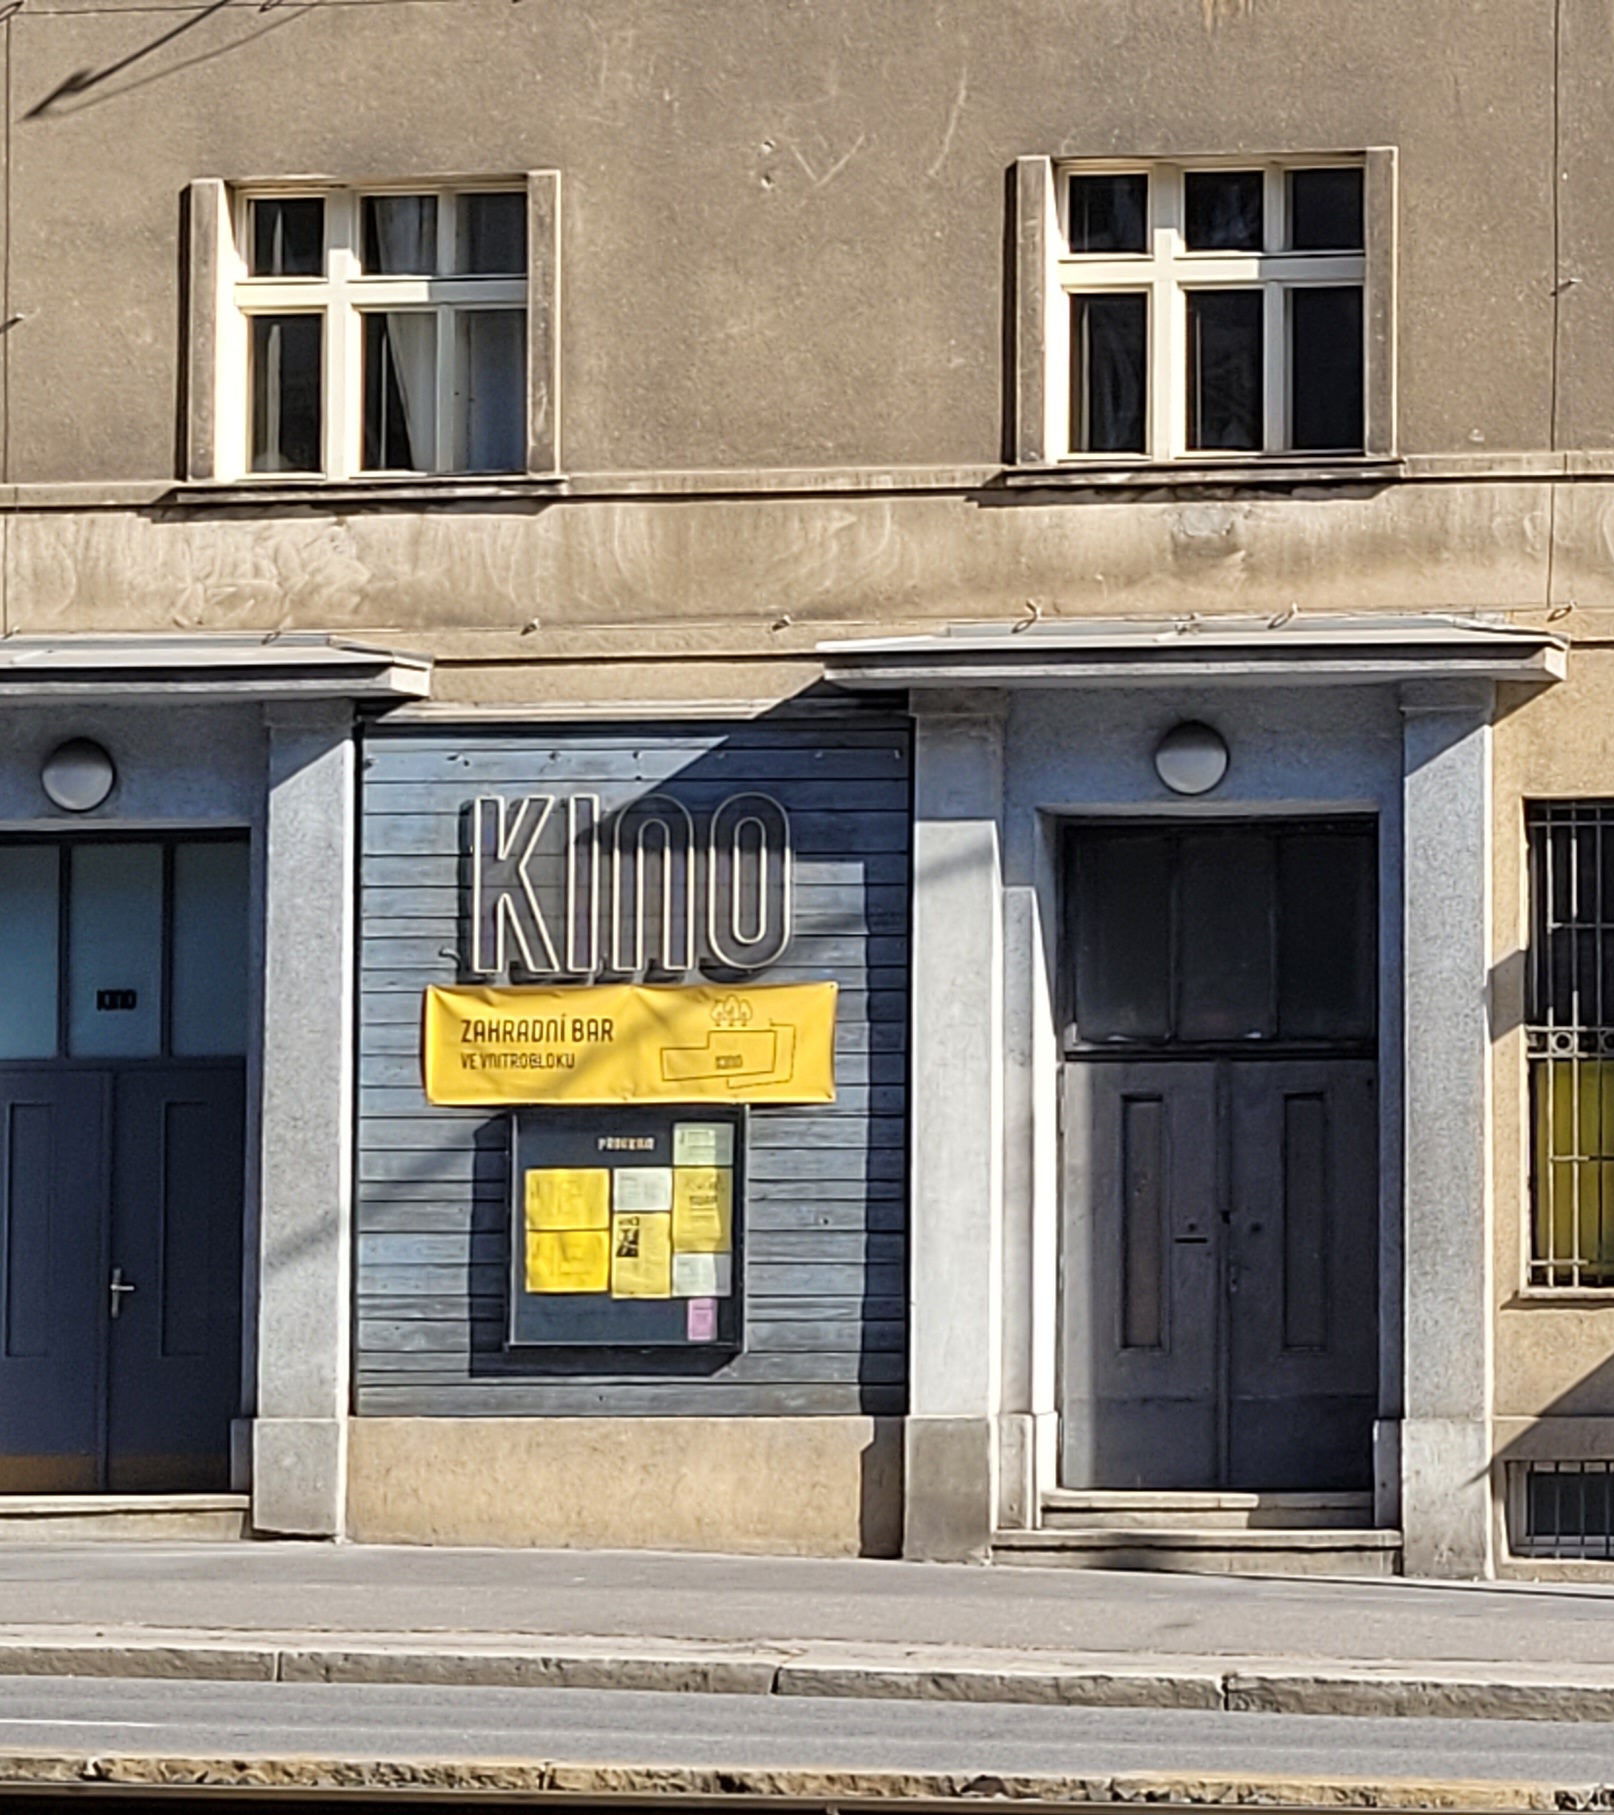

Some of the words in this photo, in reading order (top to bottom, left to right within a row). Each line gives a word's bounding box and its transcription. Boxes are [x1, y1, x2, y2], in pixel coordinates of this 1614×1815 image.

[472, 791, 791, 973] KINO
[460, 1012, 566, 1043] ZAHRADNÍ
[571, 1018, 614, 1043] BAR
[460, 1053, 477, 1070] VE
